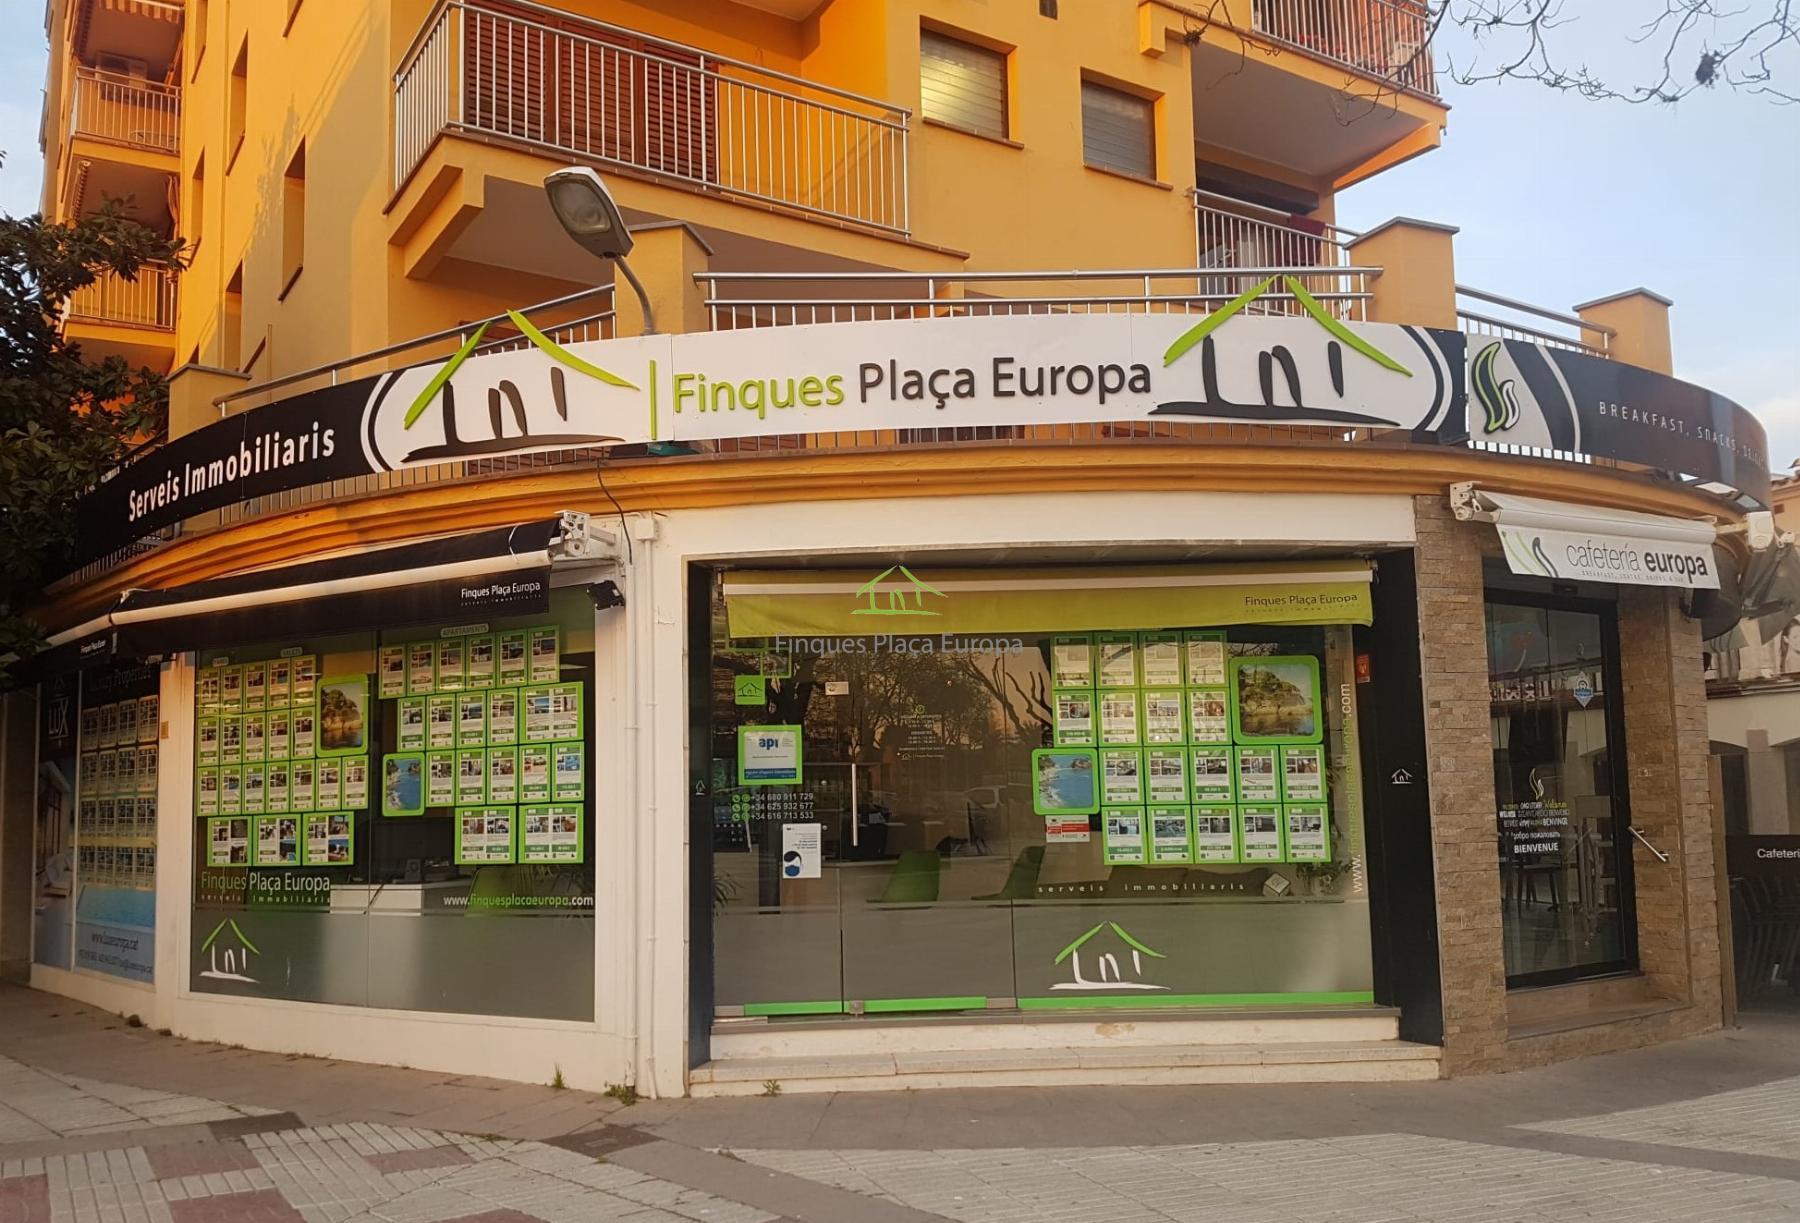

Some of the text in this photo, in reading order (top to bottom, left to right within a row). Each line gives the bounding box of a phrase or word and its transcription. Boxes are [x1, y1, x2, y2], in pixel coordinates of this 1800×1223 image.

[673, 356, 1152, 420] Finques Plaça Europa
[1599, 400, 1690, 437] BREAKFAST,
[128, 420, 336, 522] Serveis Immobiliaris
[1565, 539, 1709, 584] cafetería europa
[461, 587, 490, 600] Finques
[491, 584, 511, 597] Plaça
[512, 582, 541, 594] Europa
[1244, 595, 1287, 607] Finques
[1319, 593, 1358, 604] Europa
[758, 738, 779, 751] api
[1513, 842, 1559, 854] BIENVENUE
[201, 871, 331, 896] Finques Plaça Europa
[1037, 882, 1245, 893] serveis immobiliaris
[443, 892, 594, 908] www.finquesplacaeuropa.com
